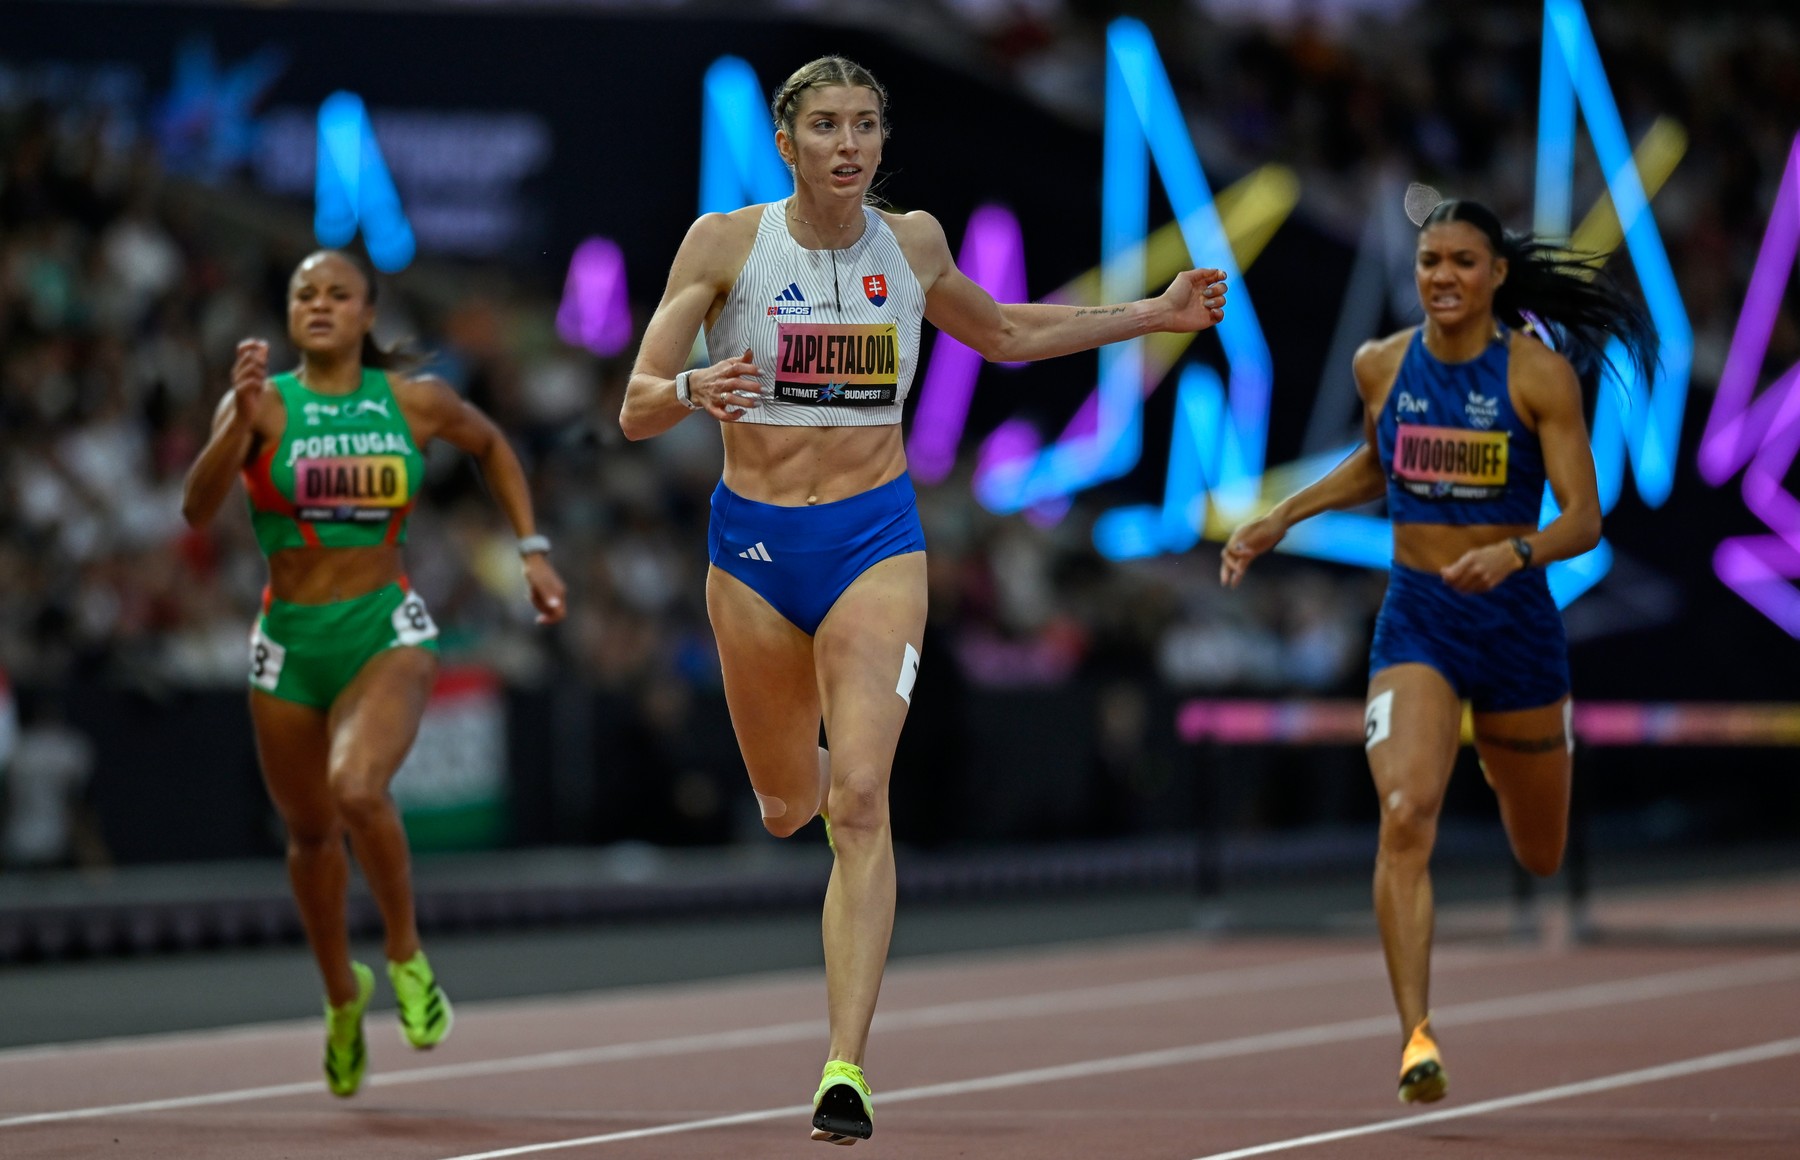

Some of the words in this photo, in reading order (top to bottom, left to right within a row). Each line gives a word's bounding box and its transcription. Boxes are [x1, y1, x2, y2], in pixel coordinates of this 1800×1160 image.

[779, 307, 810, 315] TIPOS
[782, 387, 819, 399] ULTIMATE
[844, 389, 881, 400] BUDAPEST
[286, 431, 412, 467] PORTUGAL
[1401, 436, 1502, 477] WOODRUFF
[306, 466, 397, 499] DIALLO
[405, 602, 427, 631] 8
[1365, 706, 1378, 744] 6
